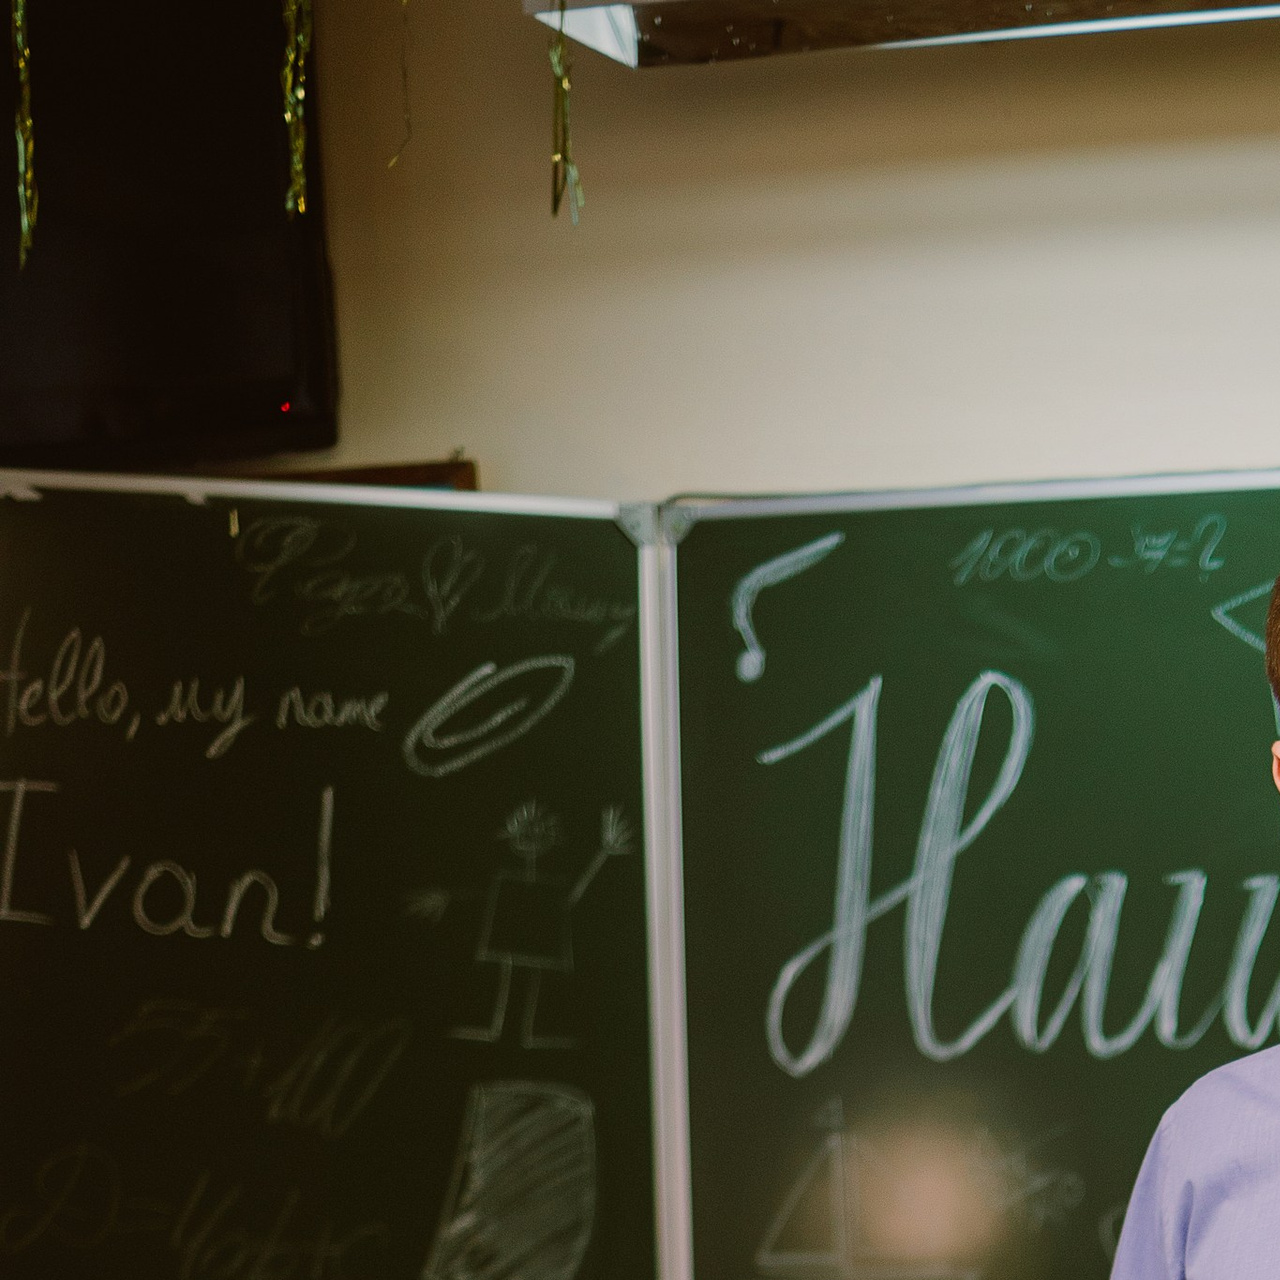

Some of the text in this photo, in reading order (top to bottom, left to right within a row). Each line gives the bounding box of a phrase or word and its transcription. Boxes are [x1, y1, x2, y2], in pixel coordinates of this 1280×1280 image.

[155, 675, 256, 760] my
[276, 686, 390, 733] name
[0, 778, 336, 948] Ivan!
